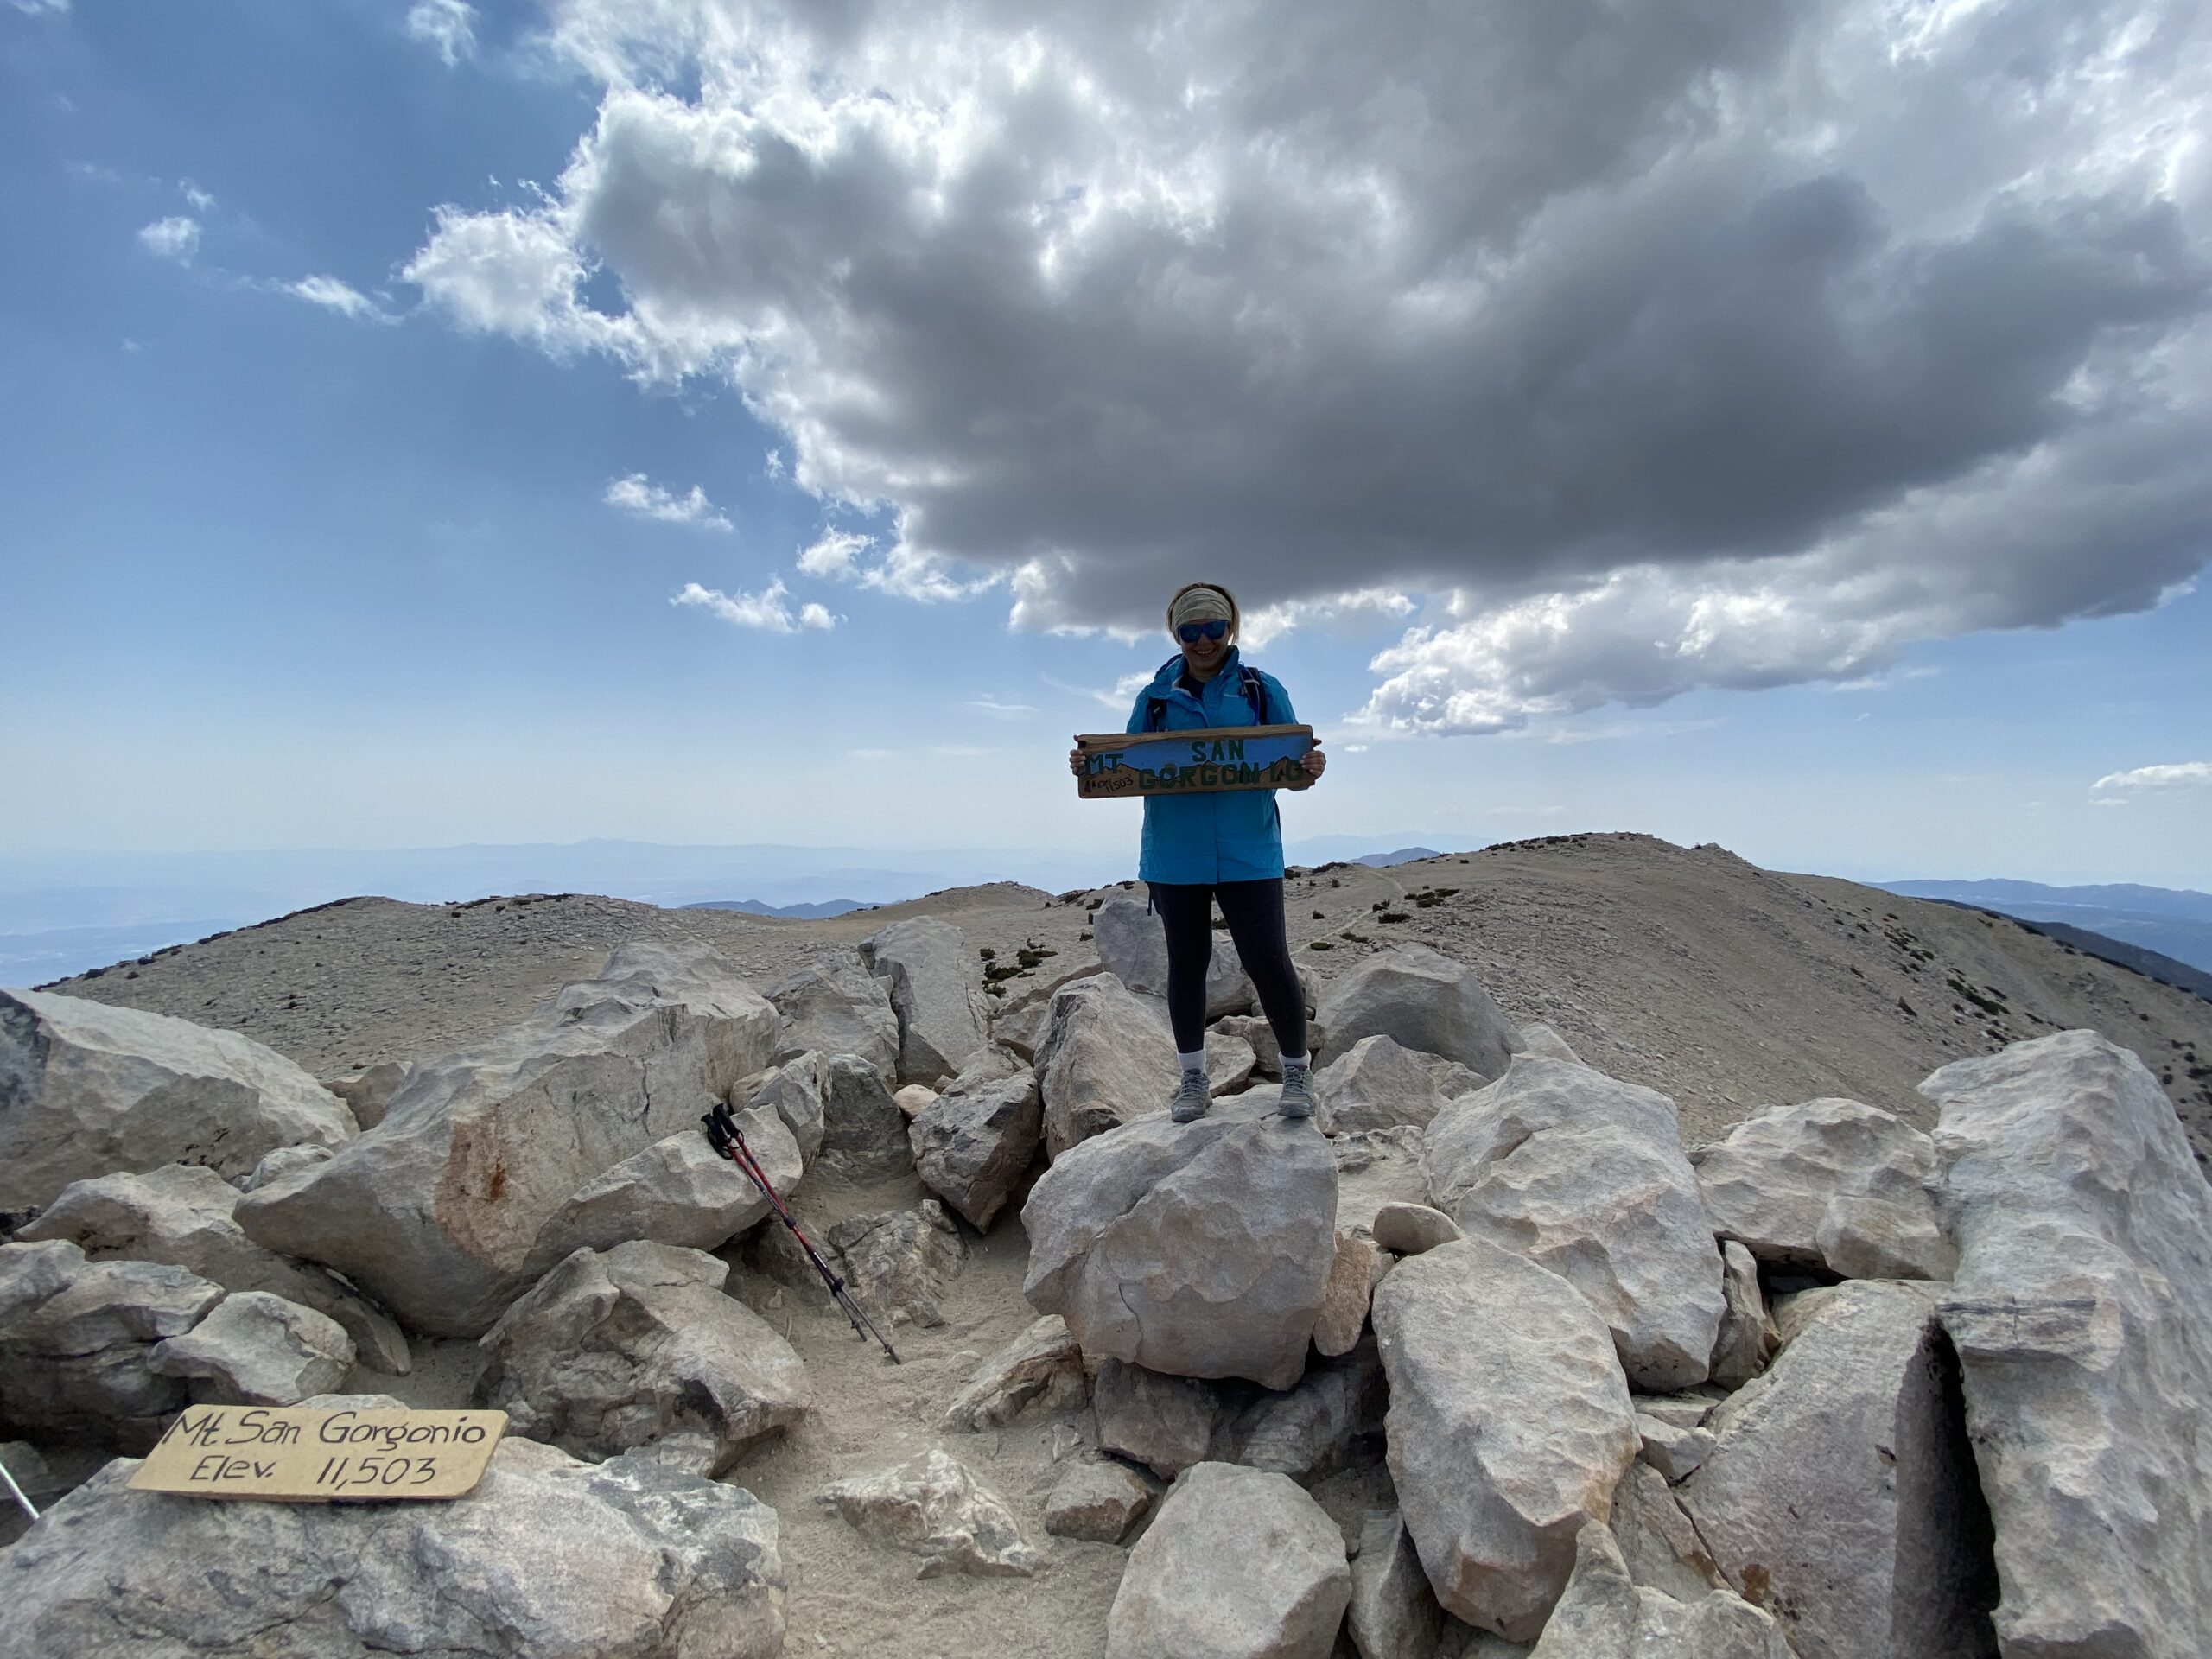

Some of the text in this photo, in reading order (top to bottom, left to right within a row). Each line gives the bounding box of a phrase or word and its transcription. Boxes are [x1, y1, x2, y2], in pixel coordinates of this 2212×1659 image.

[1192, 739, 1244, 761] SAN
[1139, 760, 1305, 790] GORGONIO
[225, 1410, 301, 1444] San
[319, 1411, 486, 1451] Gorgonio
[189, 1455, 436, 1491] Elev. 11,503
